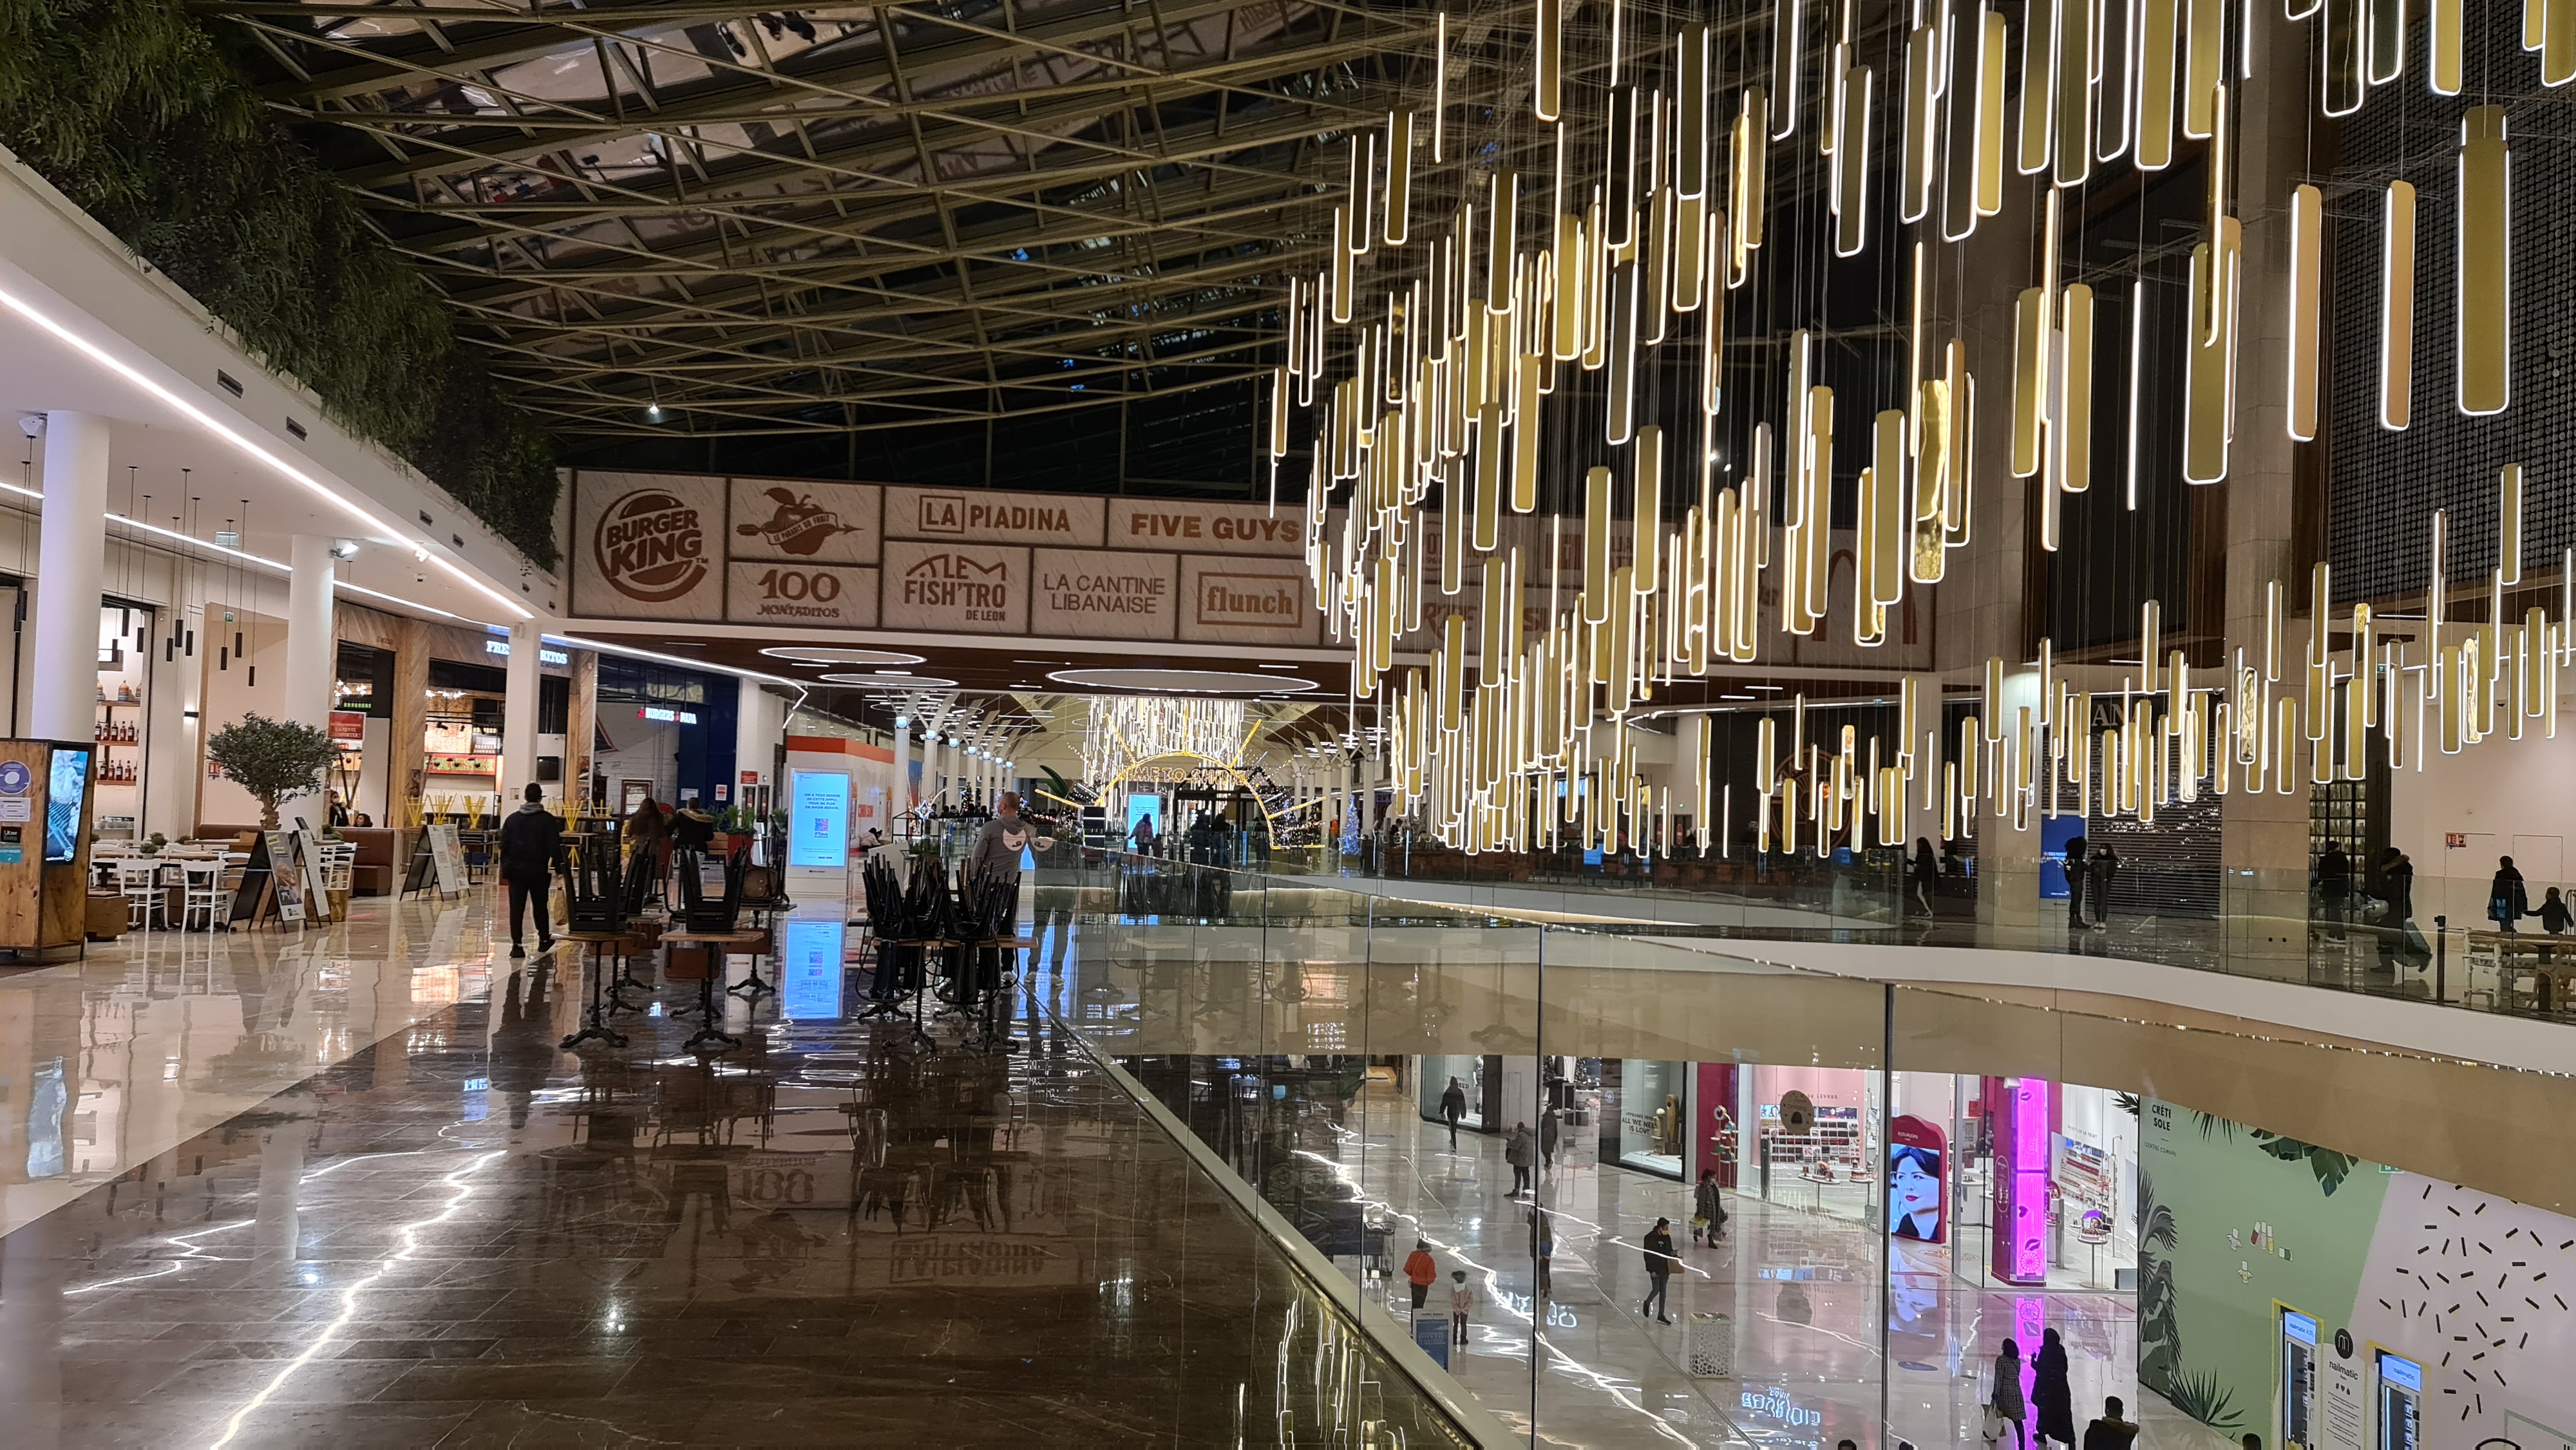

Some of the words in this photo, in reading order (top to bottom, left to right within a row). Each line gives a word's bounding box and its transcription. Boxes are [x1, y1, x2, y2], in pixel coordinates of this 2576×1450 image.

[606, 509, 699, 549] BURGER
[925, 502, 957, 527] LA
[970, 504, 1071, 532] PIADINA
[1131, 513, 1202, 538] FIVE
[1211, 516, 1300, 543] GUYS
[610, 529, 703, 578] KING
[757, 569, 840, 603] 100
[904, 579, 1007, 608] FISH'TRO
[1043, 573, 1070, 592] LA
[1076, 575, 1166, 596] CANTINE
[757, 603, 840, 618] MONTADITOS
[1051, 593, 1157, 614] LIBANAISE
[1206, 585, 1294, 616] flunch
[965, 610, 978, 621] DE
[981, 610, 1006, 622] LEON
[486, 640, 510, 655] FRE
[540, 649, 567, 664] RITOS
[2329, 1360, 2359, 1381] nailmatic
